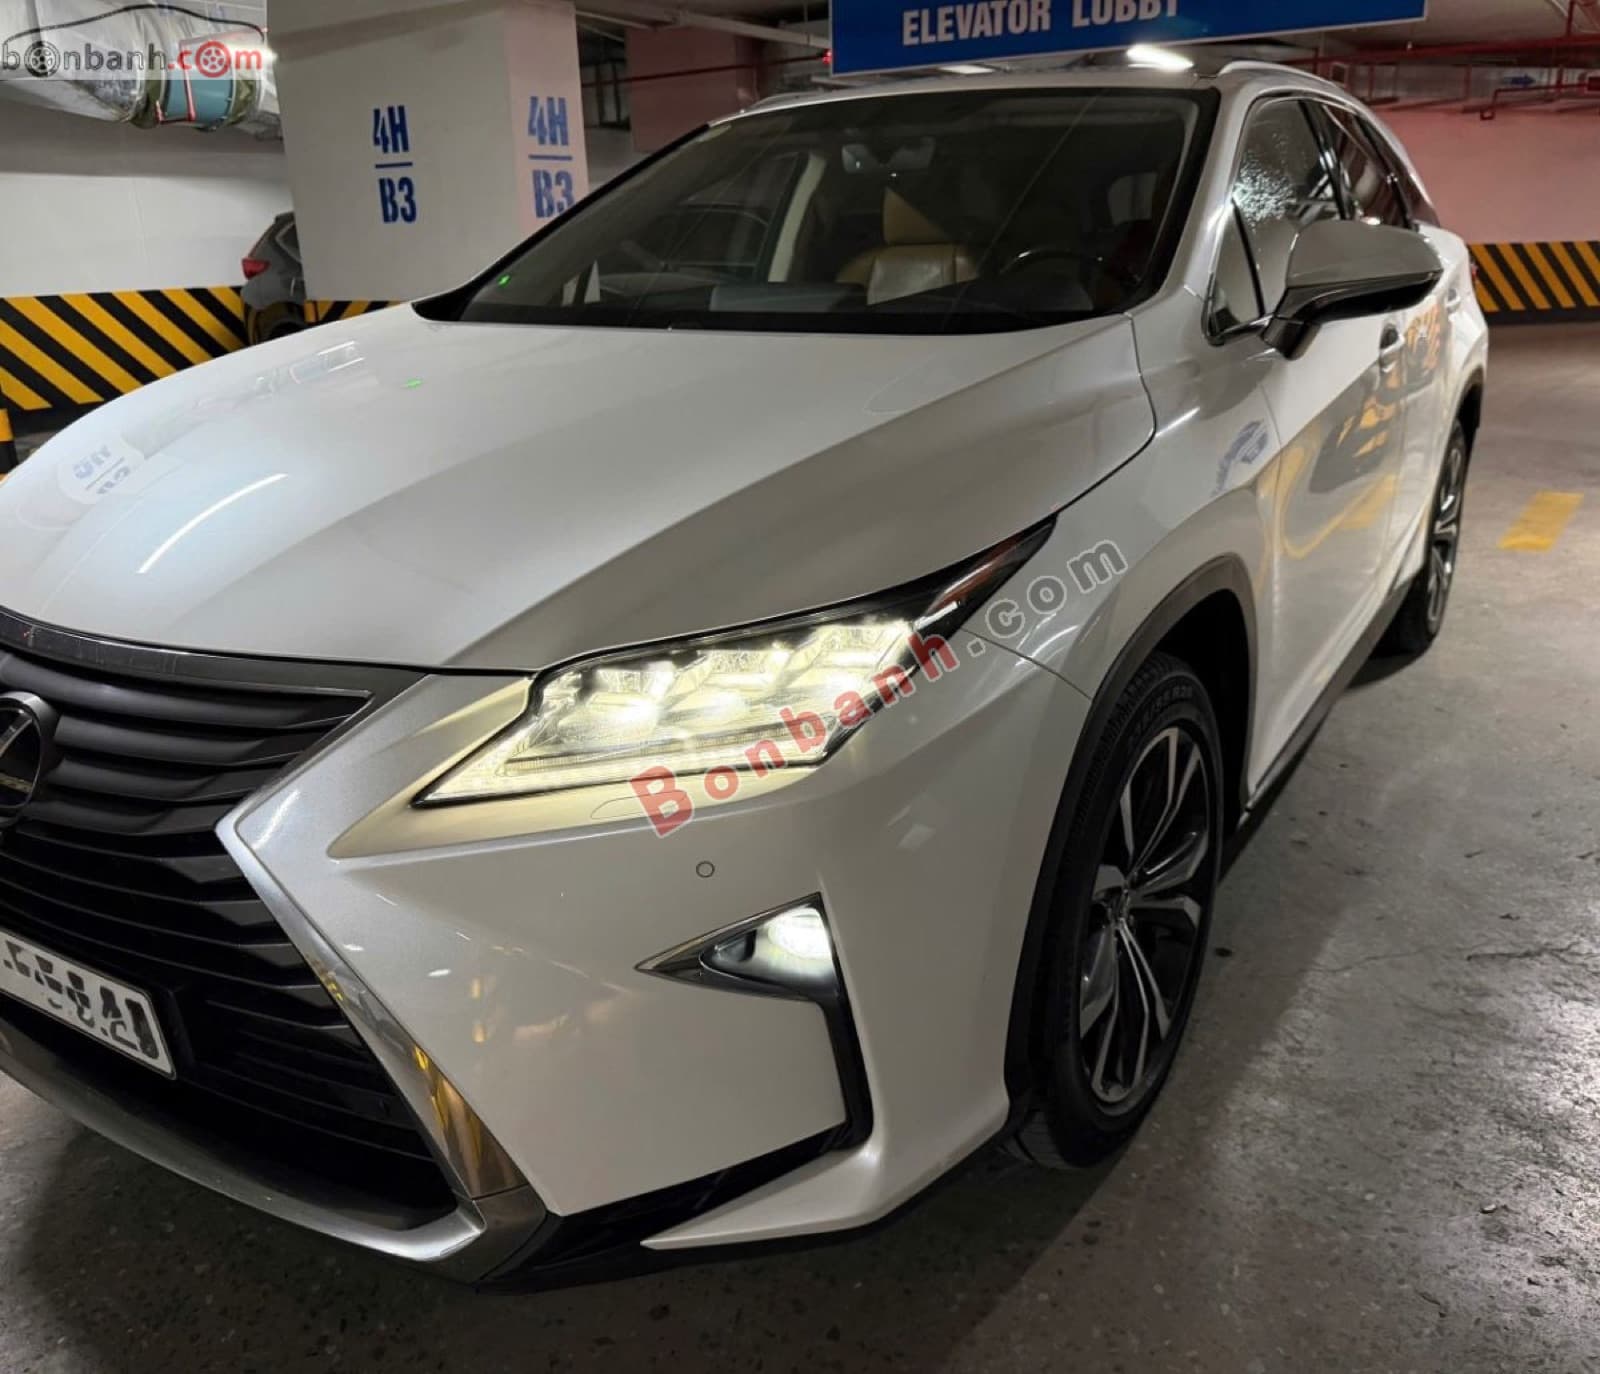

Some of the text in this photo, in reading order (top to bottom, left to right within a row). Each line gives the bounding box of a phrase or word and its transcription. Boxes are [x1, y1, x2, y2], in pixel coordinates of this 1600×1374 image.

[903, 0, 1051, 45] ELEVATOR
[373, 105, 410, 154] 4H
[528, 96, 569, 146] 4H
[379, 177, 417, 223] B3
[532, 169, 574, 219] B3
